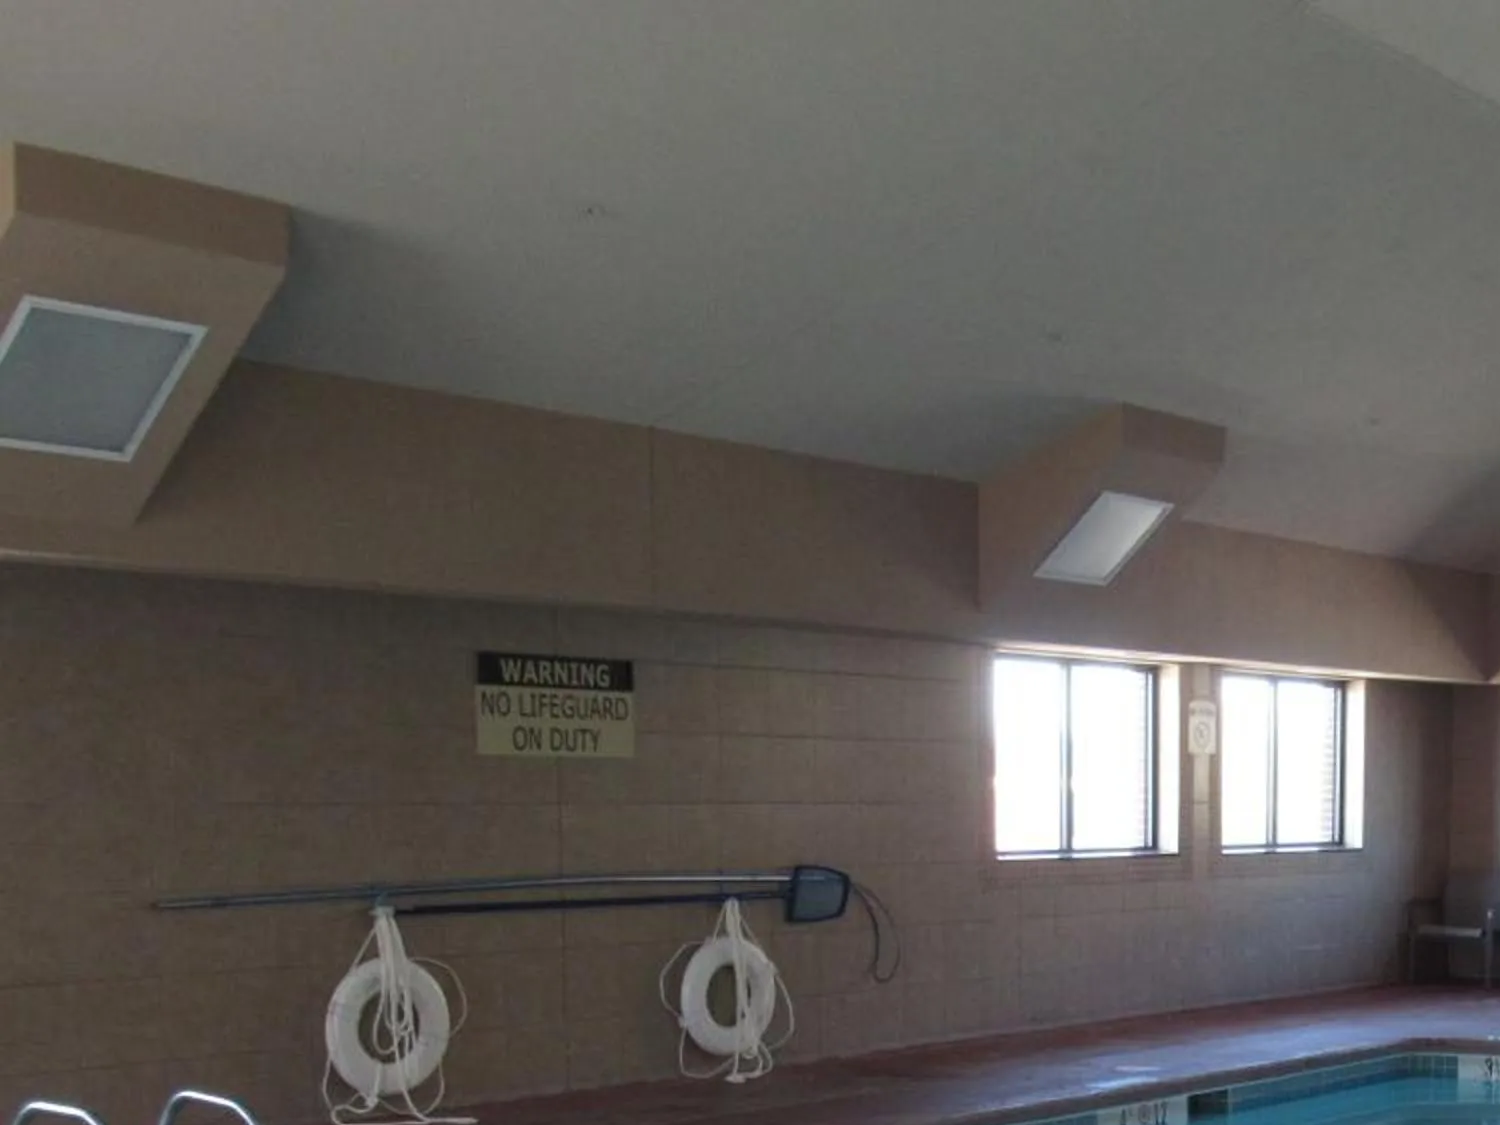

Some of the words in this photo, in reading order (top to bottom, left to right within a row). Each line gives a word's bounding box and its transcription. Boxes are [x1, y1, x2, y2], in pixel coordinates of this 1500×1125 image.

[500, 658, 611, 688] WARNING
[480, 691, 511, 717] NO
[518, 693, 629, 721] LIFEGUARD
[512, 726, 542, 752] ON
[550, 728, 601, 752] DUTY
